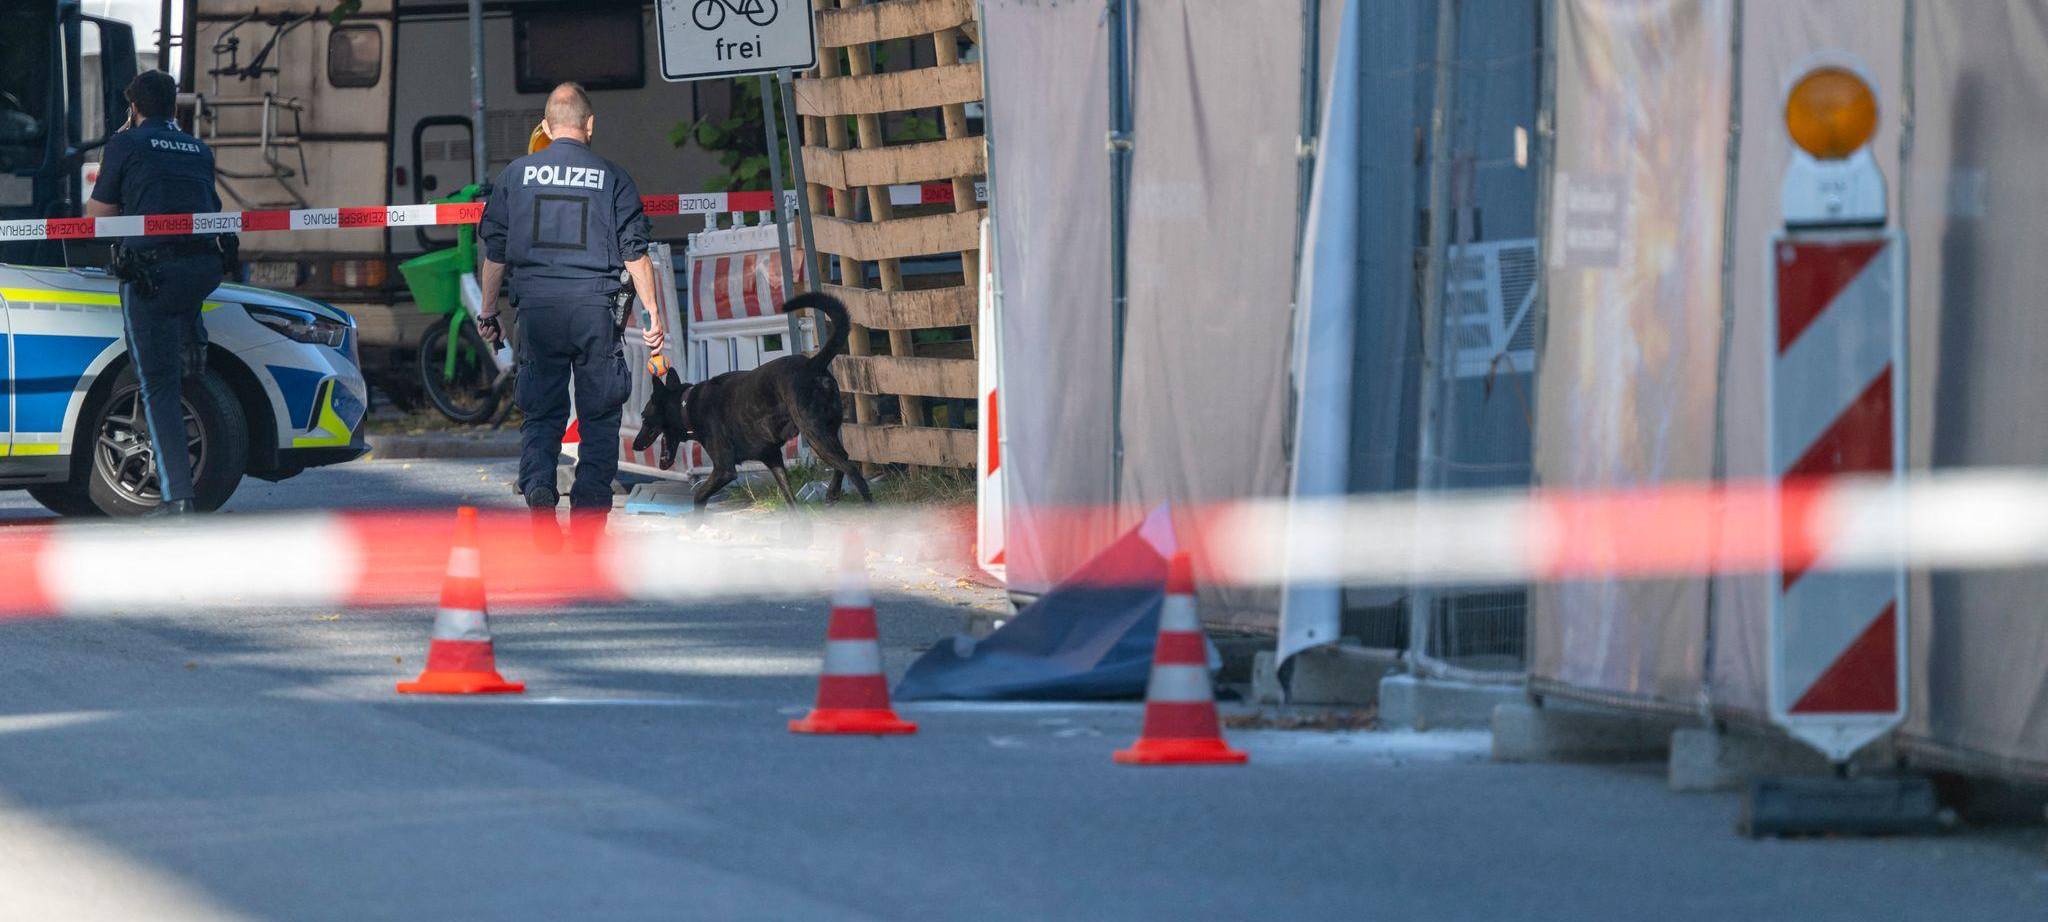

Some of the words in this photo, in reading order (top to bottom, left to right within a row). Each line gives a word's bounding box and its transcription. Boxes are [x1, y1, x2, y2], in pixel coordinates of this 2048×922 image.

[716, 35, 761, 60] frei
[151, 139, 200, 152] POLIZEI
[523, 165, 605, 189] POLIZEI
[147, 216, 249, 231] POLIZEIABSPERRUNG
[303, 210, 405, 226] POLIZEIABSPERRUNG
